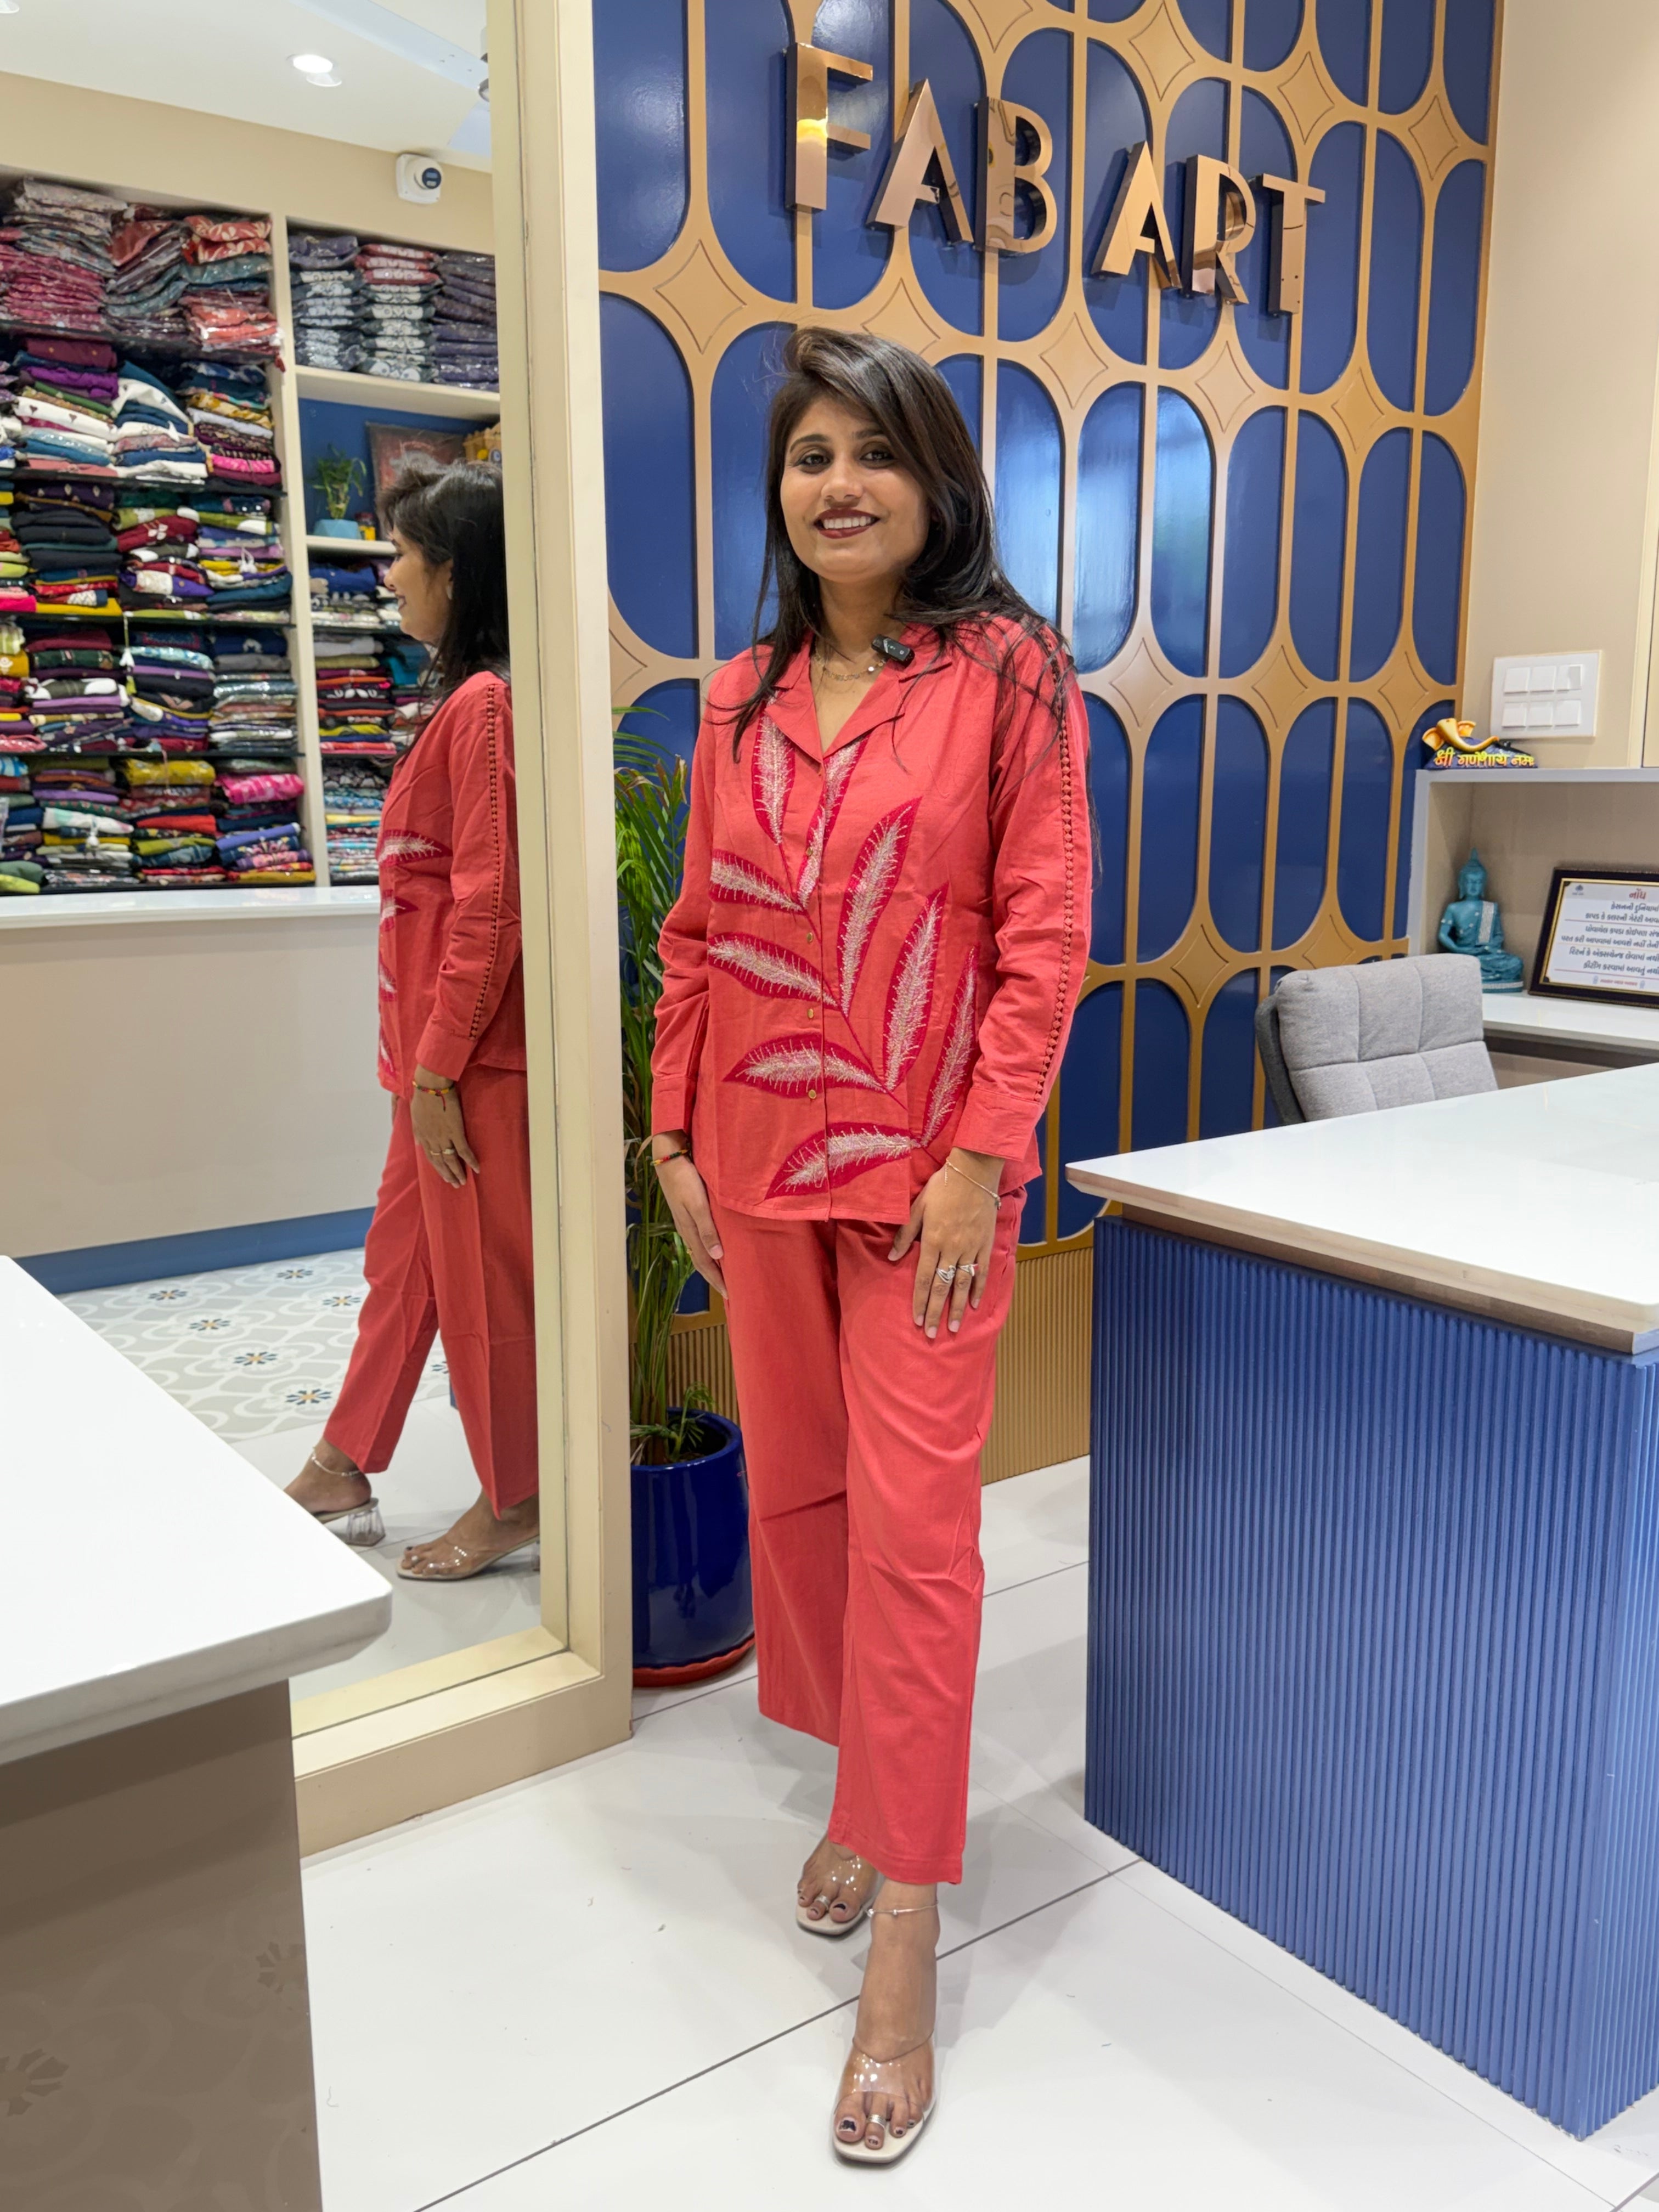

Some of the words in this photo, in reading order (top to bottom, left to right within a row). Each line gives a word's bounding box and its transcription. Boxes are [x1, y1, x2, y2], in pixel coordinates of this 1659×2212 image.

[785, 42, 1058, 254] FAB
[1091, 140, 1326, 316] ART
[1434, 747, 1455, 767] श्री
[1629, 888, 1646, 899] નોંધ
